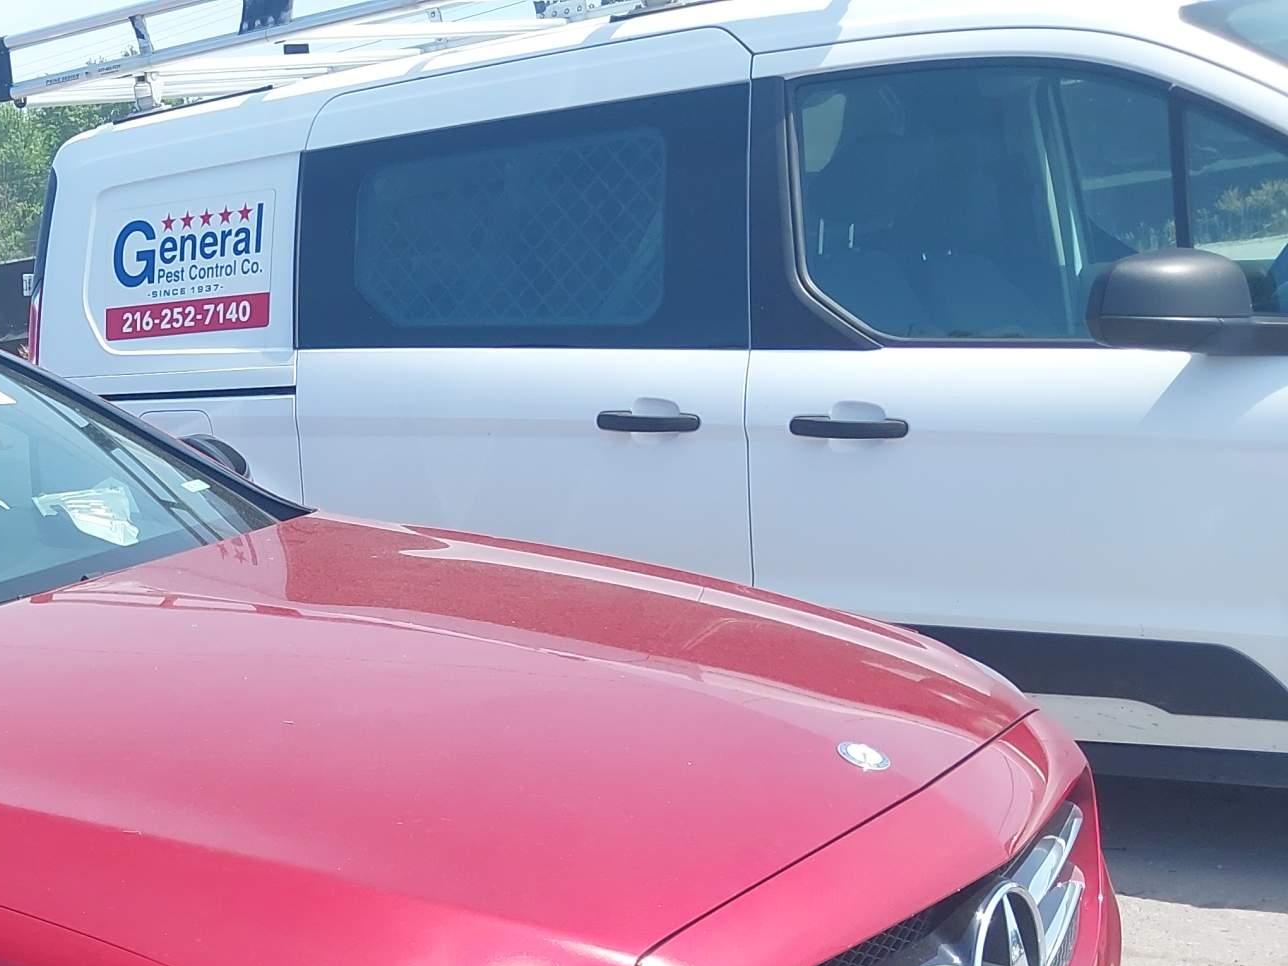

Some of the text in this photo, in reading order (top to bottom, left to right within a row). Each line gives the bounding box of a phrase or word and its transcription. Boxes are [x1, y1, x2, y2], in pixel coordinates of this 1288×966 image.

[114, 203, 264, 288] General
[157, 258, 263, 284] Pest Control Co.
[122, 300, 251, 333] 216-252-7140
